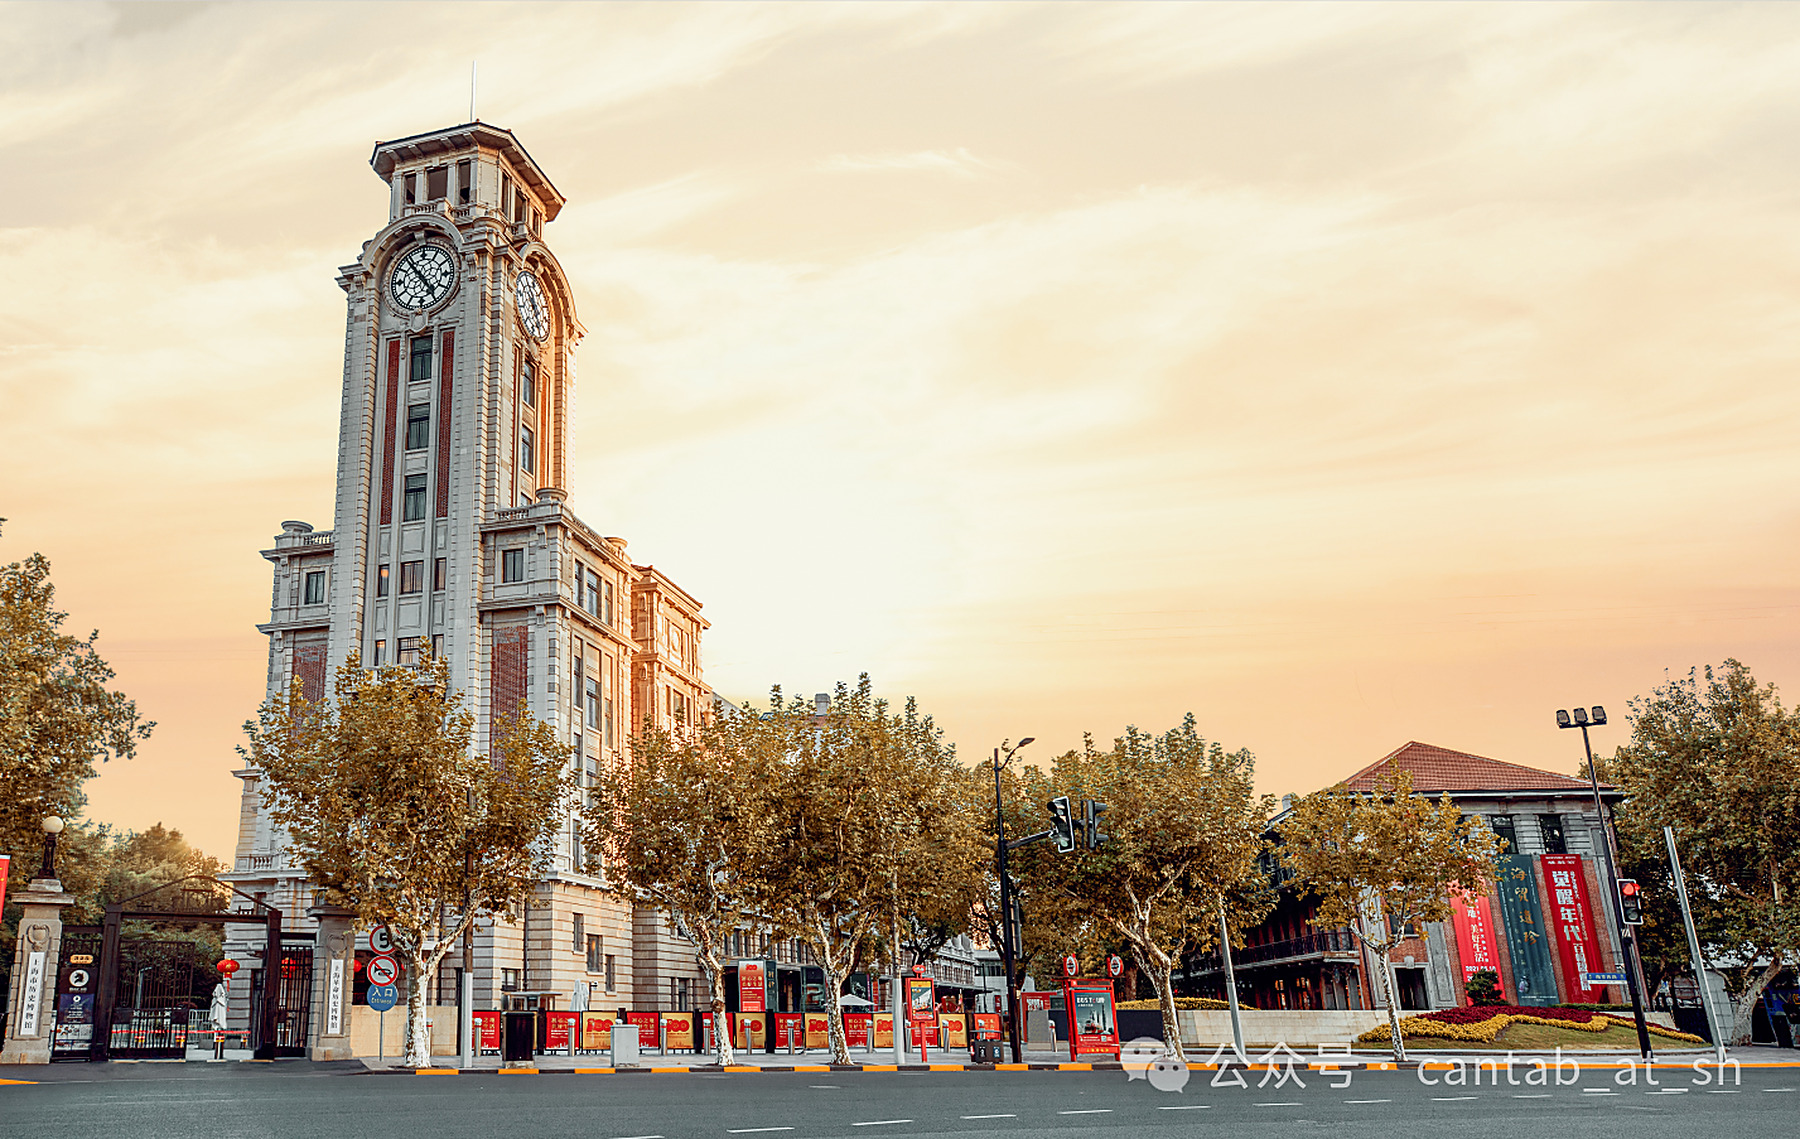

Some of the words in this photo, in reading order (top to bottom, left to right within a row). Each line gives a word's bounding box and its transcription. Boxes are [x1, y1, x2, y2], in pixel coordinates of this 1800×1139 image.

[1552, 871, 1582, 942] 觉醒年代
[379, 932, 390, 949] 5
[372, 987, 393, 997] 入口
